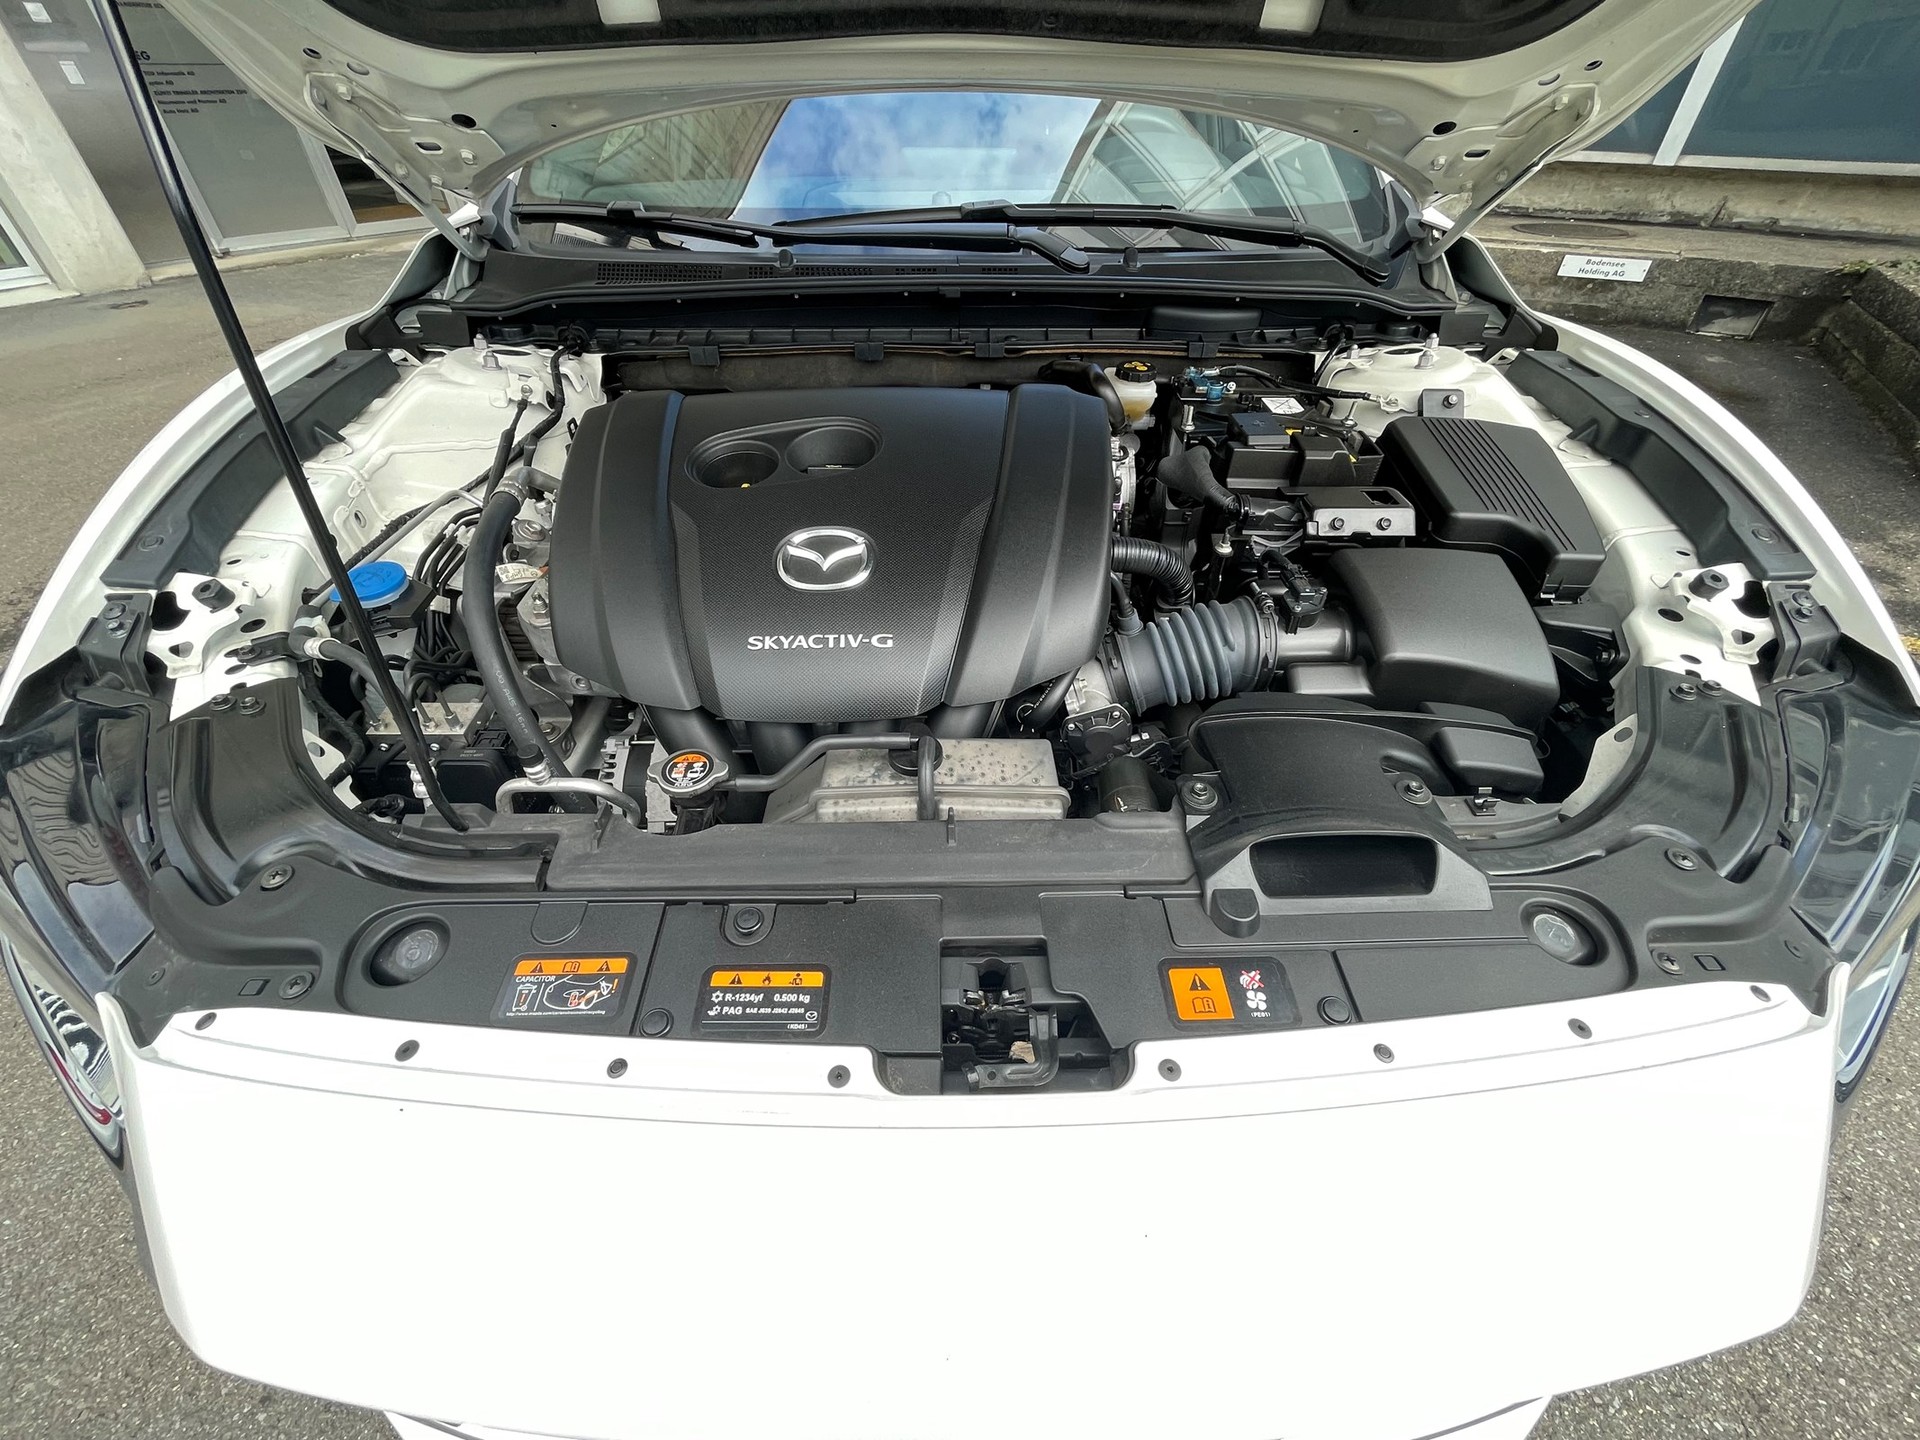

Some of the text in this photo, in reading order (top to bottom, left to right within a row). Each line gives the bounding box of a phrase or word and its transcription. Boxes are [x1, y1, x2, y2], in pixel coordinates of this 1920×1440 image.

[1585, 258, 1626, 268] Bodensee
[1578, 267, 1610, 278] Holding
[747, 633, 894, 650] SKYACTIV-G
[515, 975, 556, 983] CAPACITOR
[724, 993, 811, 1003] R-1234yf 0.500 kg
[722, 1006, 743, 1015] PAG
